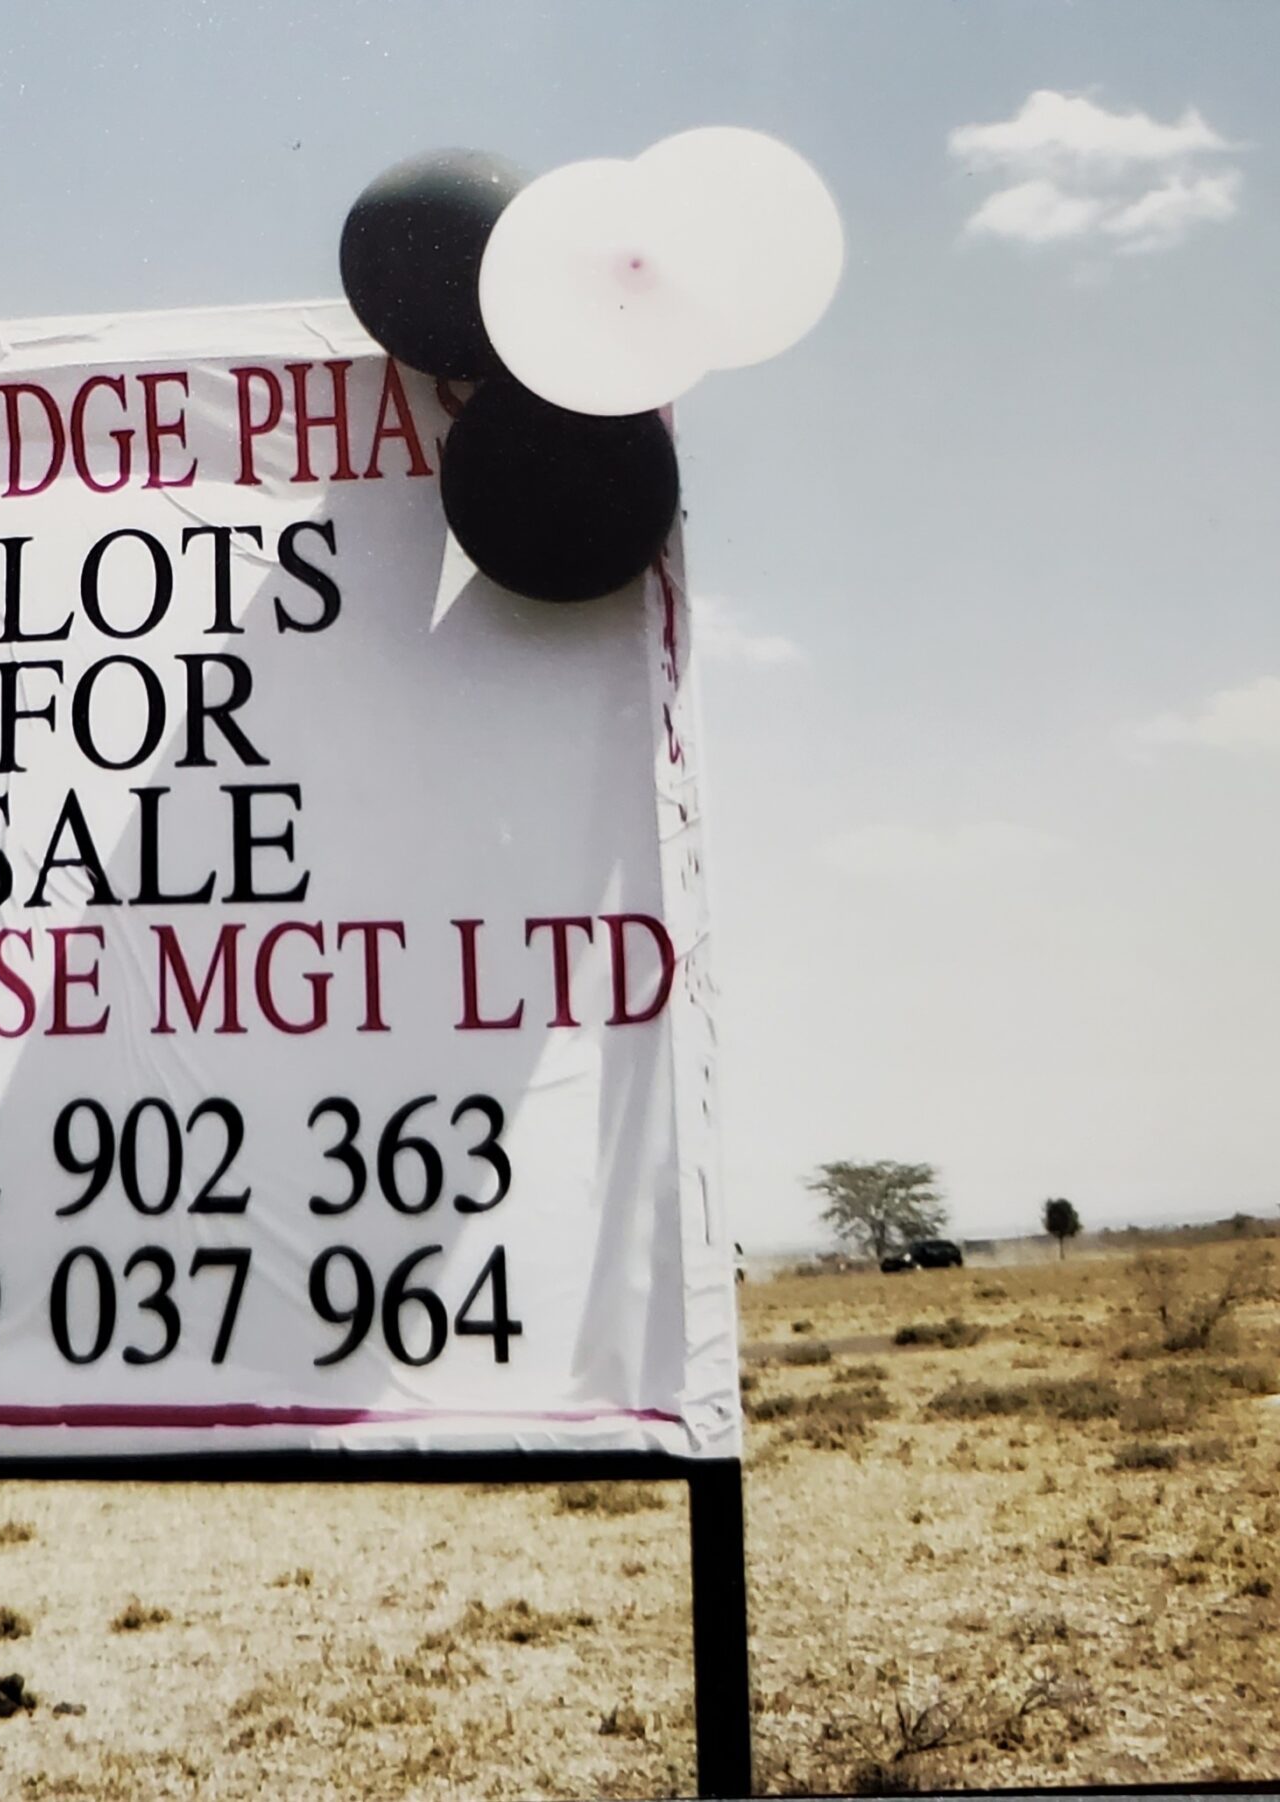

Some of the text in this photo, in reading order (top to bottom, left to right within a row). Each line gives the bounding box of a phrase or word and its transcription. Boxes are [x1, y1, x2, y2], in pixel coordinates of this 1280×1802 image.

[228, 356, 468, 487] PHA
[149, 920, 407, 1036] MGT
[449, 912, 677, 1031] LTD
[52, 1096, 252, 1219] 902
[307, 1093, 512, 1218] 363
[48, 1244, 253, 1367] 037
[307, 1243, 523, 1369] 964
